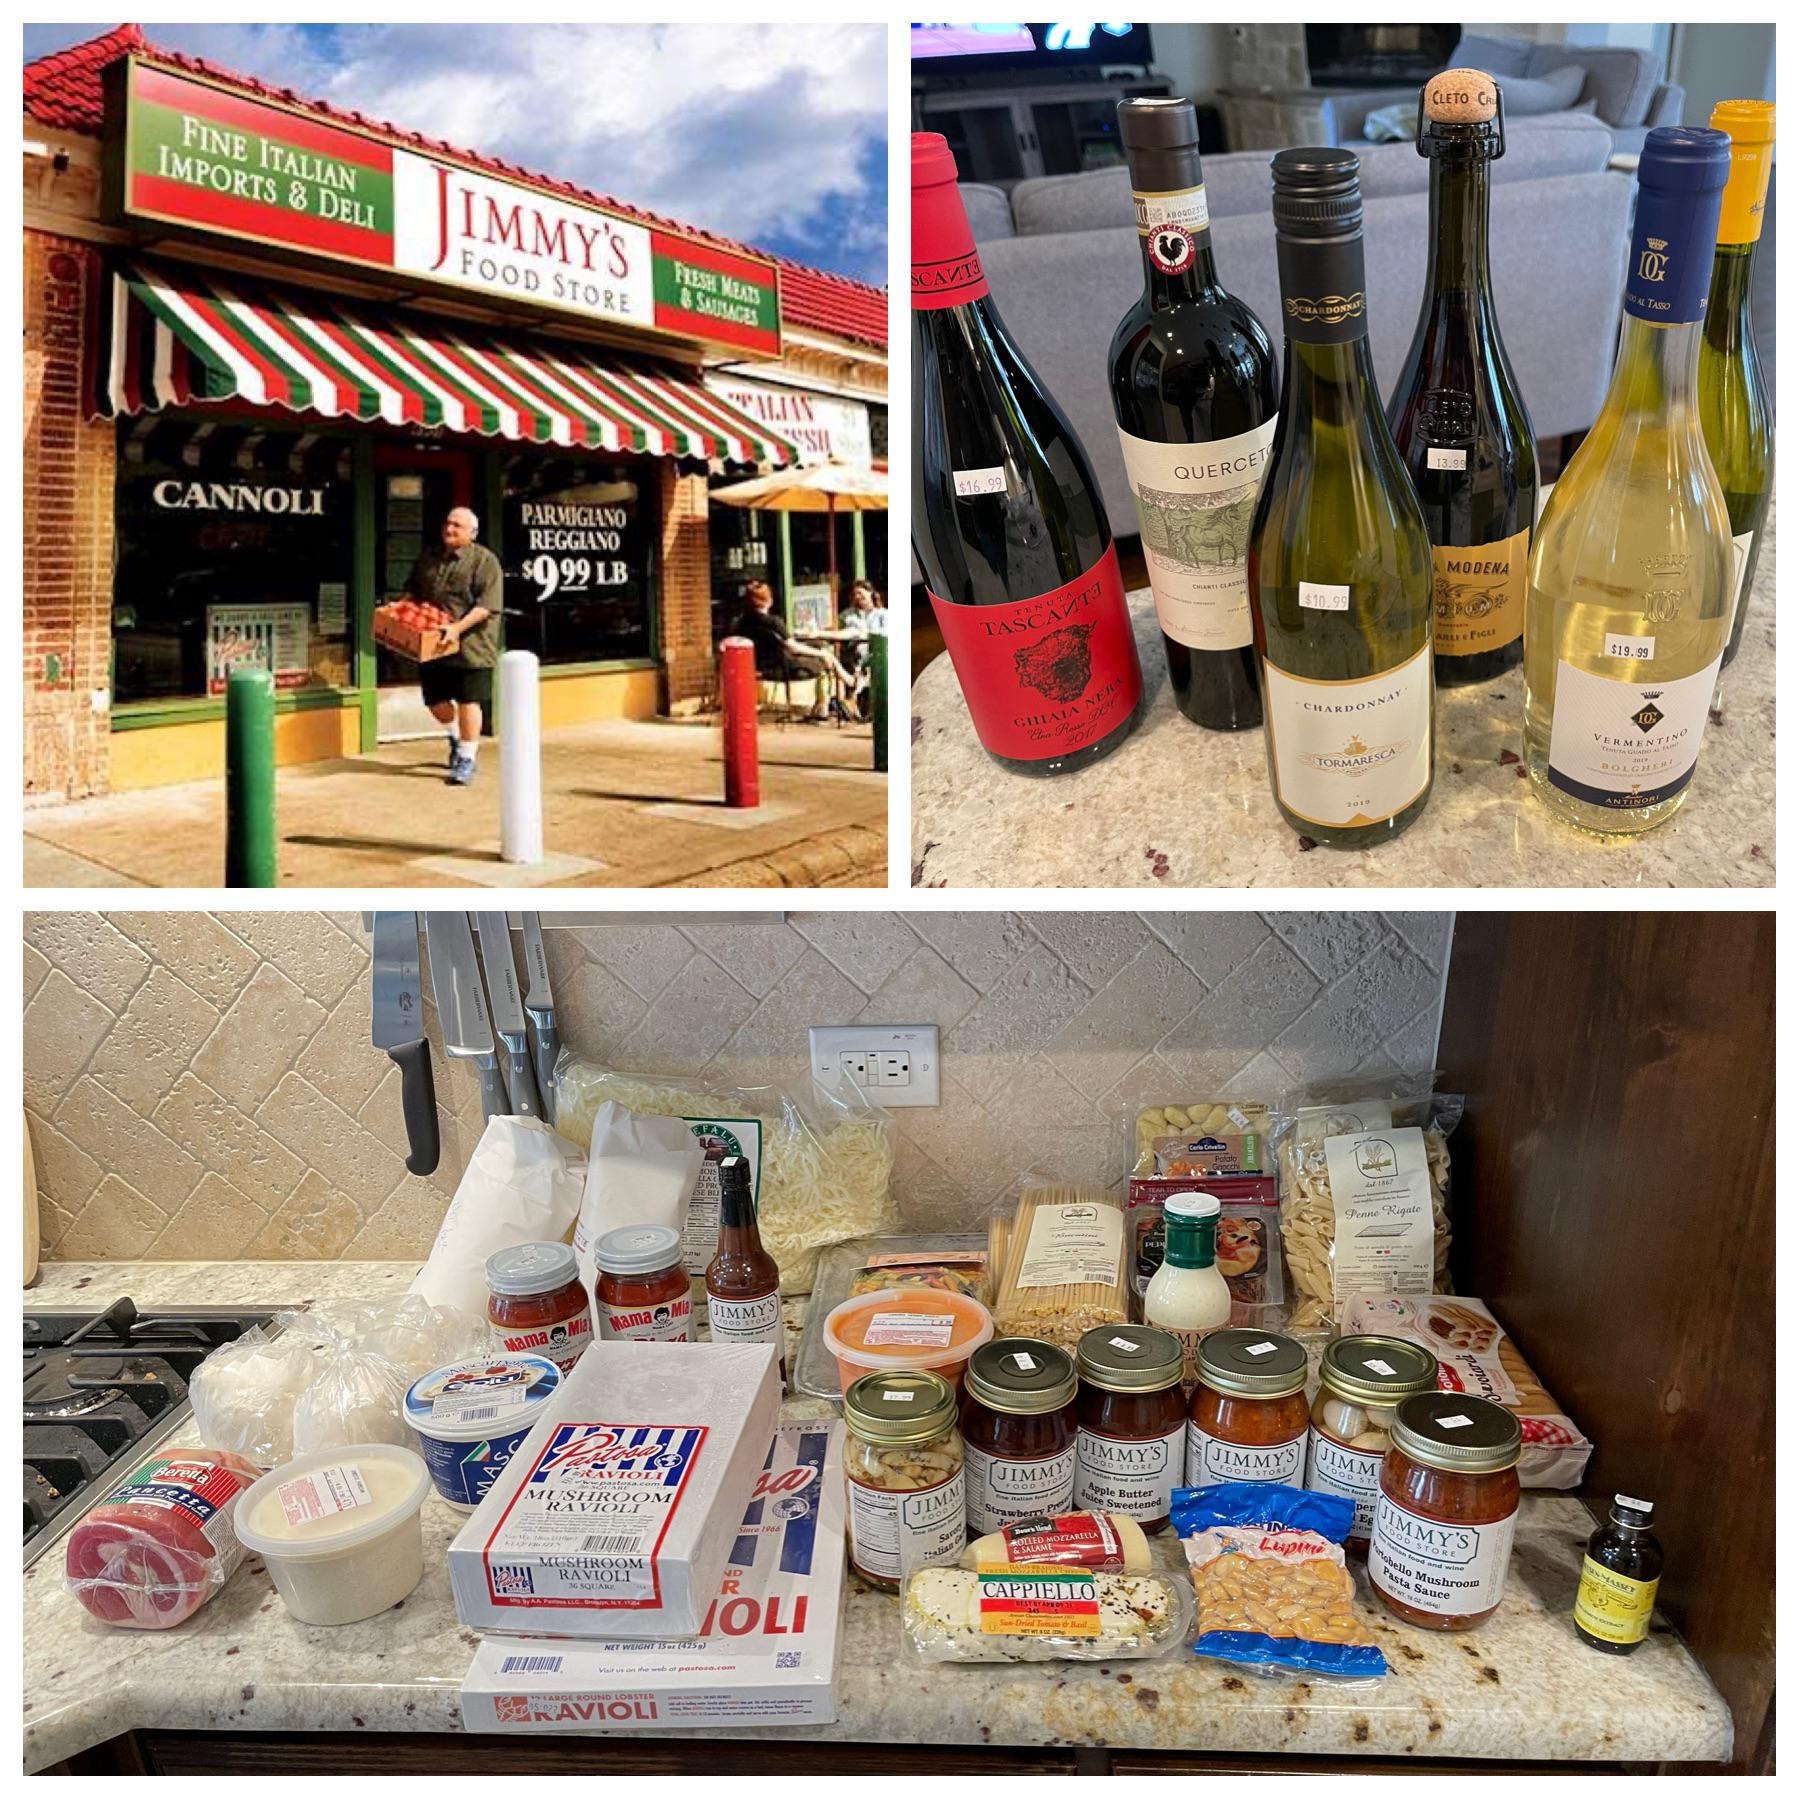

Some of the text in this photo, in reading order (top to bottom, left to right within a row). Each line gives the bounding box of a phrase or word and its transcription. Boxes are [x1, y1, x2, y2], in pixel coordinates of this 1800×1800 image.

[1433, 90, 1469, 105] CLETO
[182, 116, 357, 192] FINE ITALIAN
[158, 145, 375, 229] IMPORTS & DELI
[431, 164, 629, 280] JIMMY'S
[461, 249, 631, 313] FOOD STORE
[674, 261, 760, 304] FRESH MEATS
[680, 290, 759, 327] & SAUSAGES
[1298, 300, 1362, 316] CHARDONNAY
[1647, 299, 1671, 311] TASSO
[959, 476, 1003, 494] $16.99
[152, 480, 325, 516] CANNOLI
[522, 503, 627, 529] PARMIGIANO
[529, 529, 621, 552] REGGIANO
[596, 561, 629, 585] LB
[1447, 561, 1510, 575] MODENA
[1015, 593, 1075, 615] TENUTA
[1304, 594, 1348, 608] $10.99
[1611, 644, 1649, 658] $19.99
[1303, 688, 1402, 713] CHARDONNAY
[1014, 707, 1079, 729] GHIAIA
[1594, 728, 1688, 747] VERMENTINO
[1316, 748, 1396, 768] TORMARESCA
[1602, 759, 1673, 773] BOLGHERI
[1605, 795, 1659, 805] ANTINORI
[1345, 1208, 1380, 1219] Penne
[714, 1300, 775, 1319] JIMMY'S
[609, 1311, 653, 1332] Mama
[504, 1331, 549, 1352] Mama
[540, 1432, 662, 1472] Pastosa
[1082, 1438, 1161, 1463] JIMMY'S
[1212, 1447, 1295, 1468] JIMMY'S
[998, 1454, 1072, 1482] JIMMY'S
[1220, 1465, 1286, 1476] FOOD STORE
[1321, 1447, 1377, 1476] JIMM
[153, 1467, 209, 1485] Beretta
[580, 1469, 663, 1480] RAVIOLI
[1327, 1466, 1353, 1480] FOOD
[524, 1490, 673, 1503] MUSHROOM
[1081, 1489, 1162, 1509] Juice Sweetened
[1088, 1482, 1154, 1498] Apple Butter
[113, 1486, 210, 1514] Pancetta
[546, 1502, 640, 1513] RAVIOLI
[985, 1503, 1045, 1517] Strawberry
[1381, 1504, 1469, 1550] JIMMY'S
[1046, 1532, 1099, 1543] MOZZARELLA
[1260, 1537, 1326, 1556] Lupini
[1384, 1524, 1456, 1557] FOOD STORE
[924, 1542, 954, 1560] Italian
[539, 1556, 644, 1570] MUSHROOM
[1373, 1539, 1480, 1588] Portobello Mushroom
[1408, 1554, 1425, 1565] food
[1427, 1562, 1443, 1570] and
[559, 1568, 631, 1583] RAVIOLI
[1383, 1566, 1450, 1600] Pasta Sauce
[579, 1583, 616, 1591] SQUARE
[983, 1582, 1095, 1601] CAPPIELLO
[1036, 1619, 1062, 1628] Tomato
[1070, 1620, 1087, 1628] Basil
[678, 1665, 736, 1673] pastosa.com
